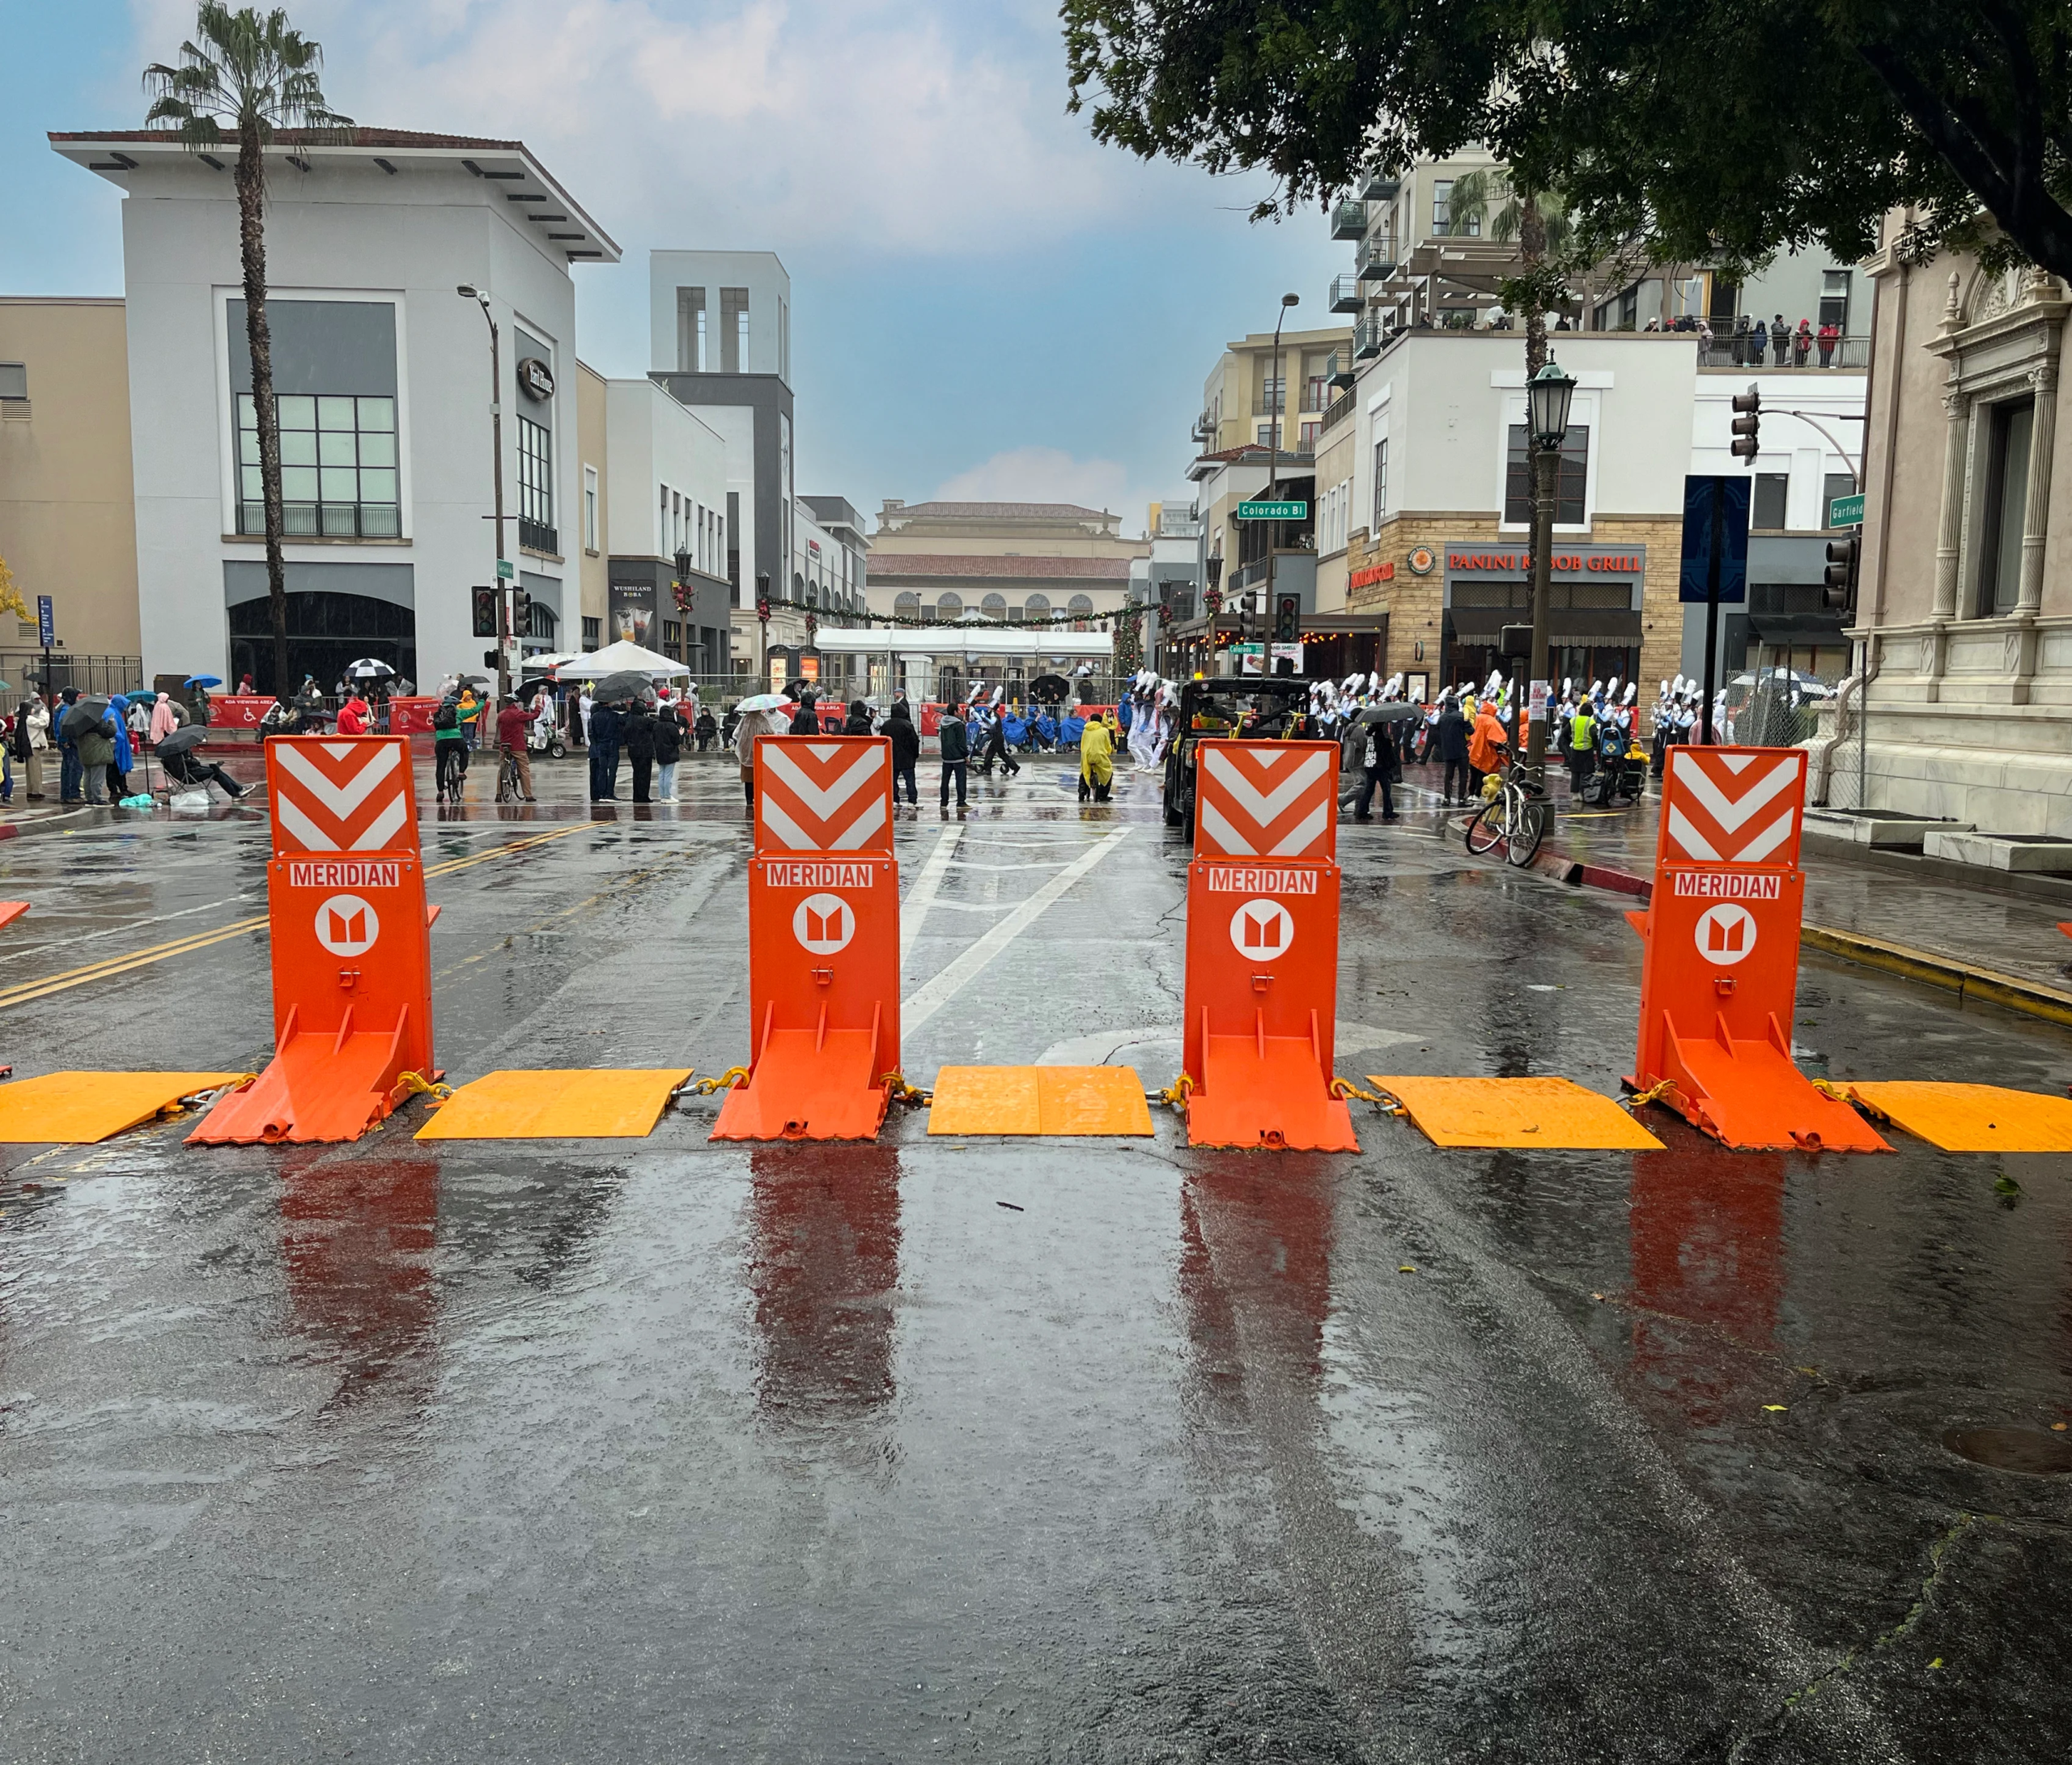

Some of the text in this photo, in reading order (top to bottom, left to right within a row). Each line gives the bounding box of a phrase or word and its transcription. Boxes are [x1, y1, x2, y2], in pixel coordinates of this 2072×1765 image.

[529, 365, 553, 393] Yard House
[1242, 505, 1289, 515] Colorado
[1832, 503, 1863, 520] Garfield
[1449, 554, 1516, 570] PANINI
[1521, 554, 1583, 571] KBOB
[1587, 555, 1642, 572] GRILL
[1230, 645, 1252, 653] Colorado
[294, 864, 396, 886] MERIDIAN
[771, 864, 869, 886] MERIDIAN
[1213, 868, 1314, 893] MERIDIAN
[1678, 873, 1777, 898] MERIDIAN
